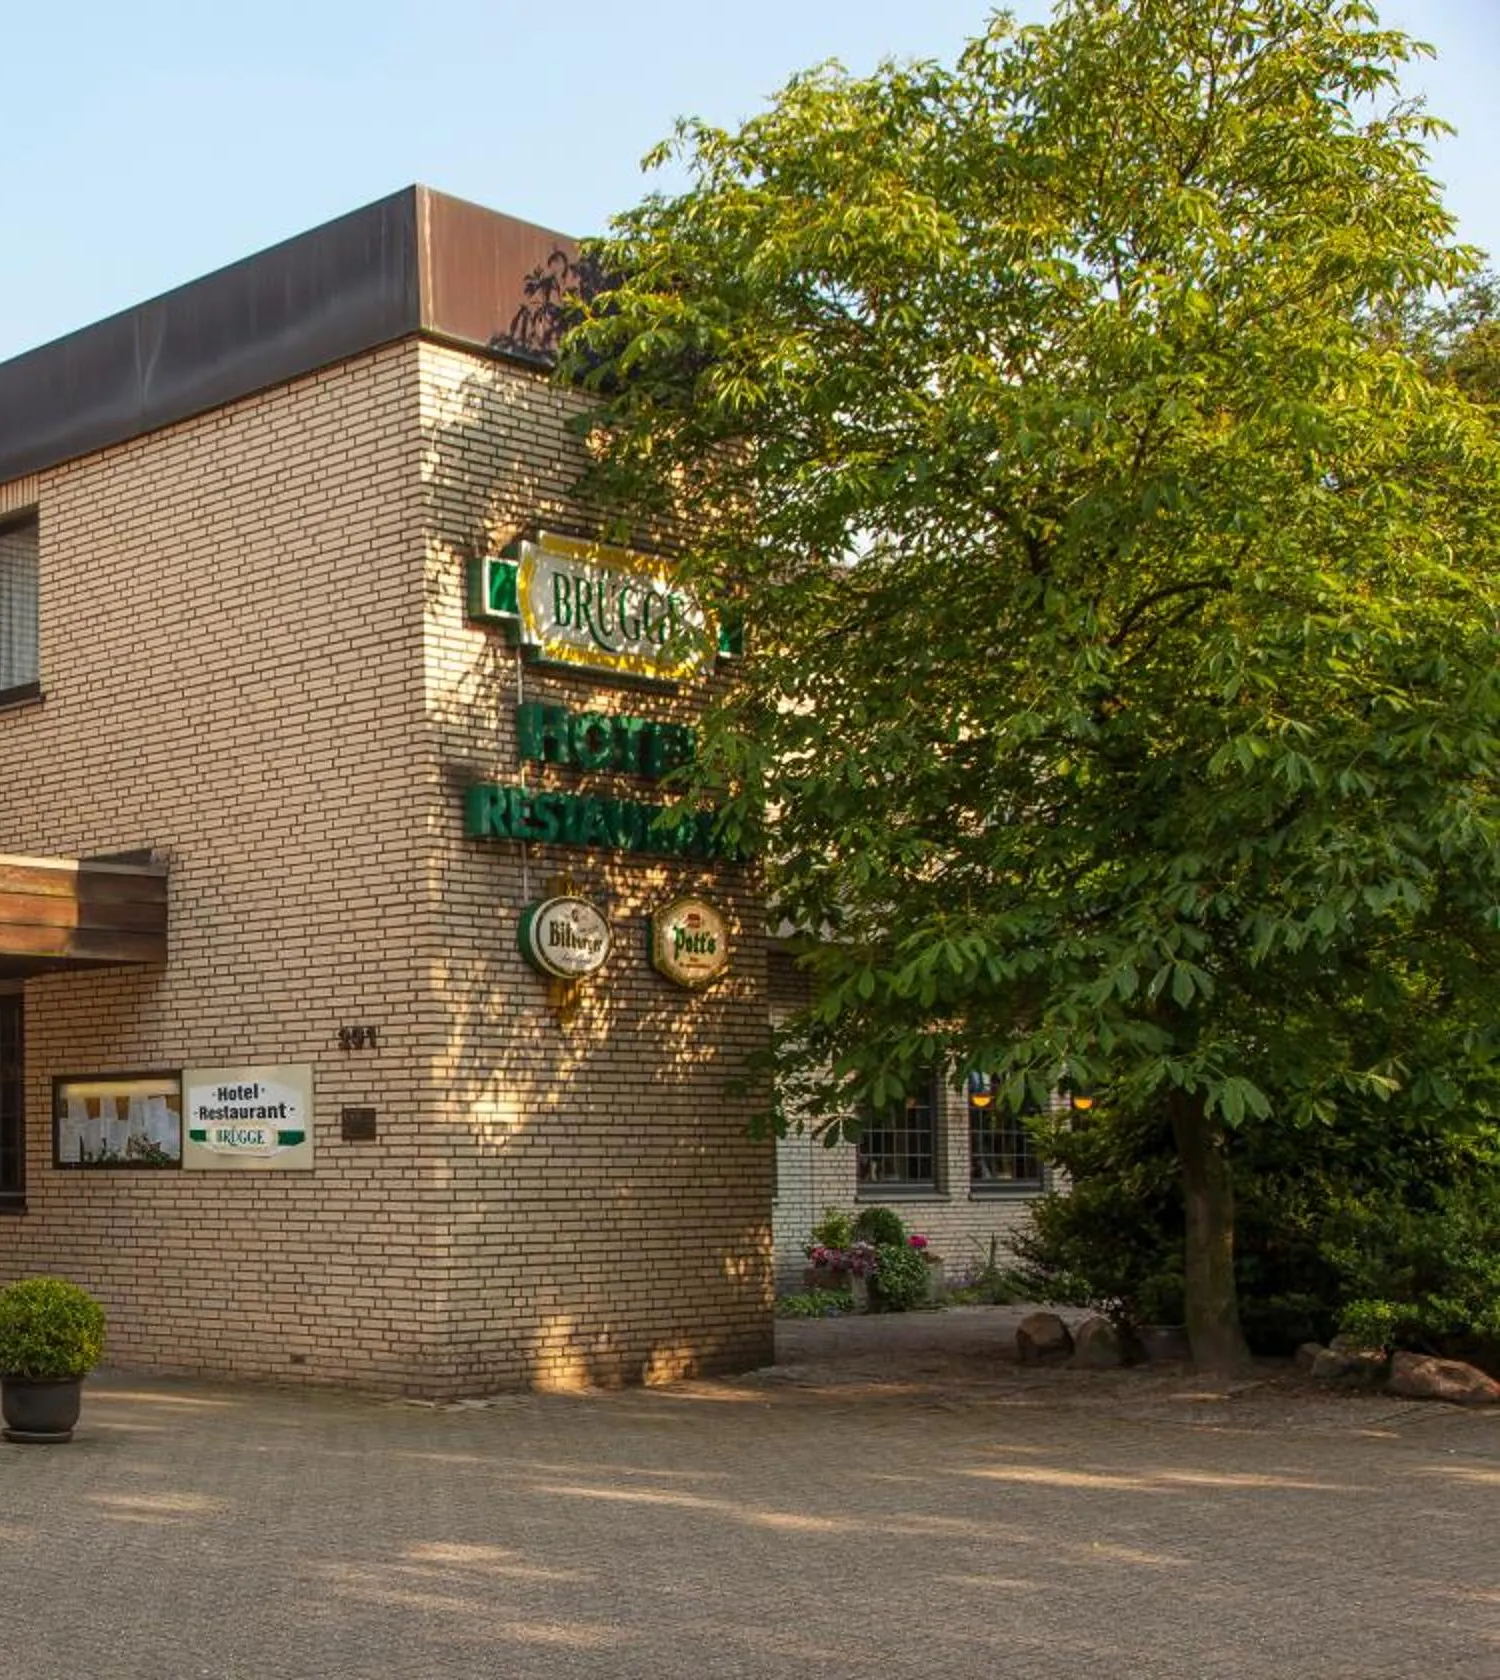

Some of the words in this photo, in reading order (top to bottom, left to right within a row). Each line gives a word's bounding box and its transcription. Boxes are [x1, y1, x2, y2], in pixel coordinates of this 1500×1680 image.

[518, 703, 698, 776] HOTE
[217, 1083, 258, 1101] Hotel
[199, 1103, 286, 1120] Restaurant
